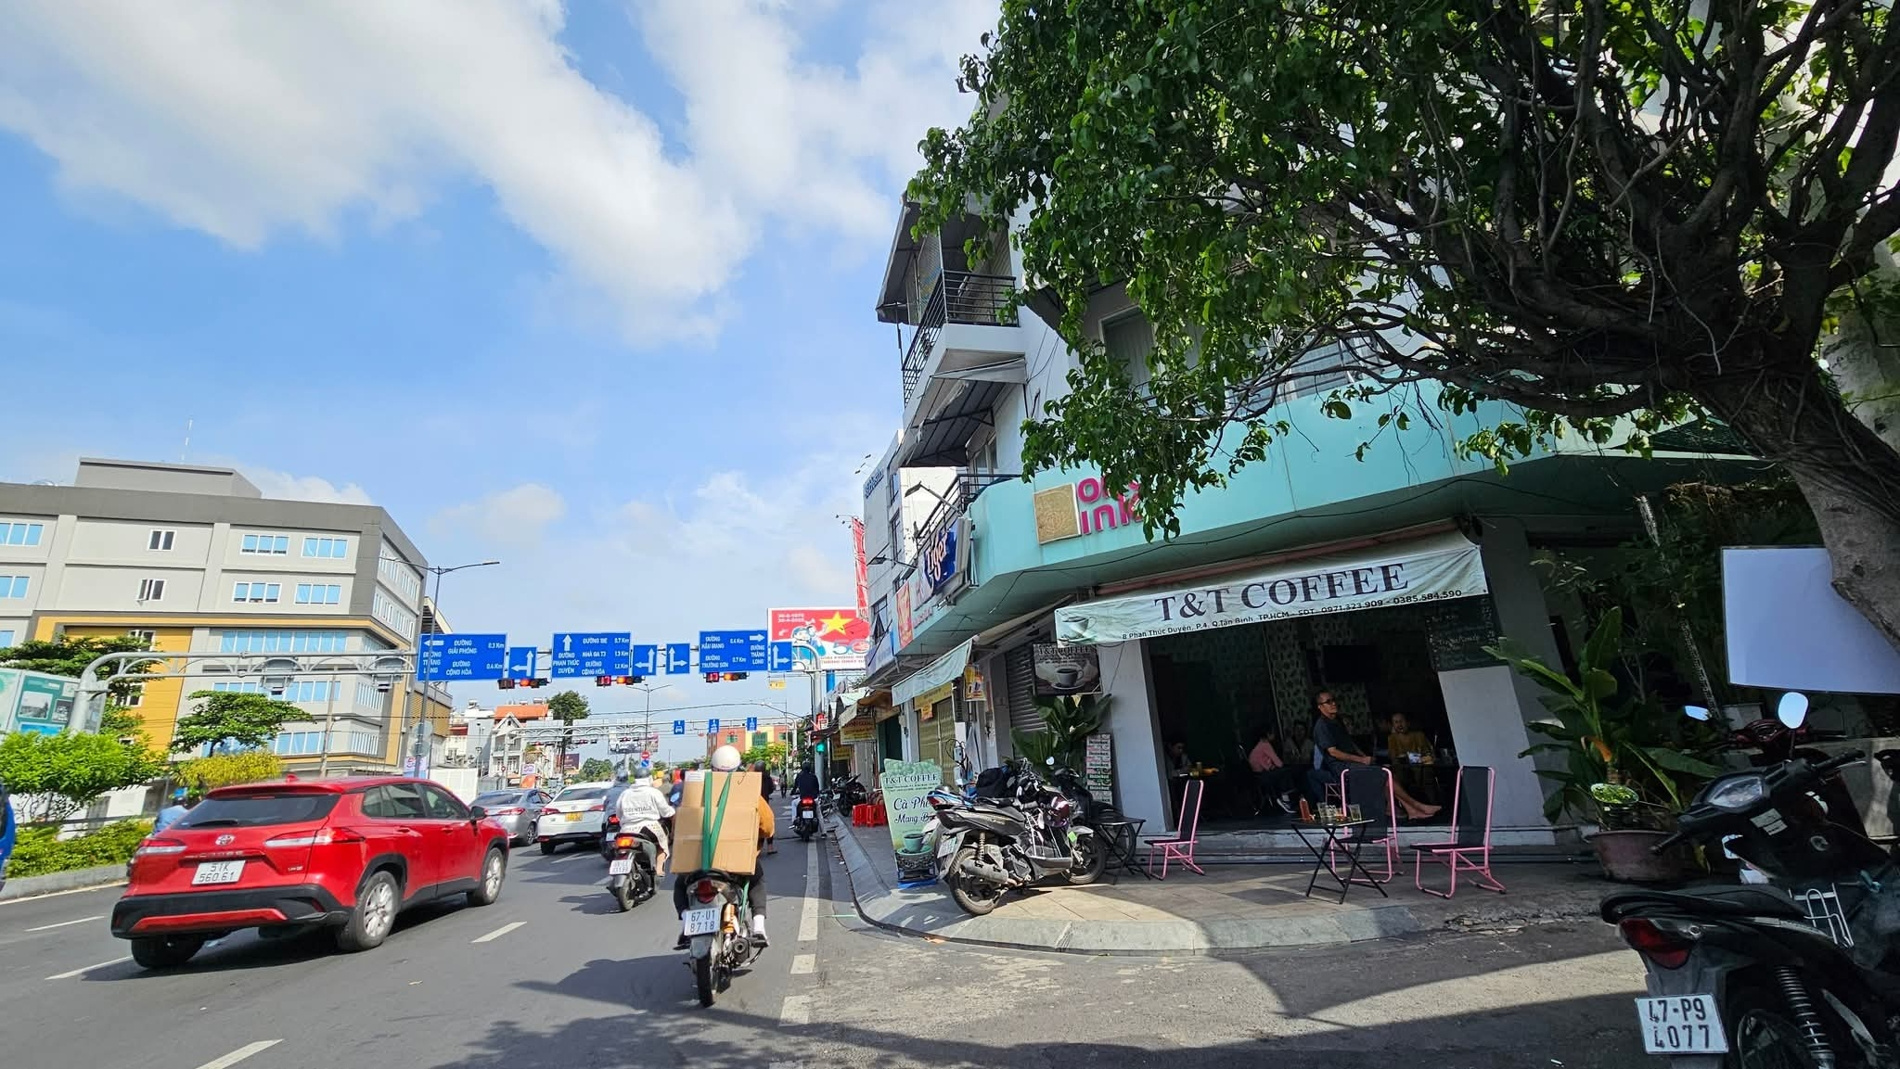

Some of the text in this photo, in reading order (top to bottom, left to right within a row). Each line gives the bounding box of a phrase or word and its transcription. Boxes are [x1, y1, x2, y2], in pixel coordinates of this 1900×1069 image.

[1154, 563, 1409, 622] T&T COFFEE
[1128, 631, 1147, 640] Phan
[1258, 610, 1290, 622] TP.HCM
[1393, 590, 1462, 605] 0385.584.590
[893, 797, 908, 811] Cà
[895, 813, 918, 825] Mang
[210, 862, 230, 873] 51K
[199, 872, 235, 883] 560.61
[691, 909, 716, 922] 67-U1
[690, 920, 715, 933] 8718
[1648, 997, 1707, 1023] 47-P9
[1653, 1024, 1709, 1049] 4077
